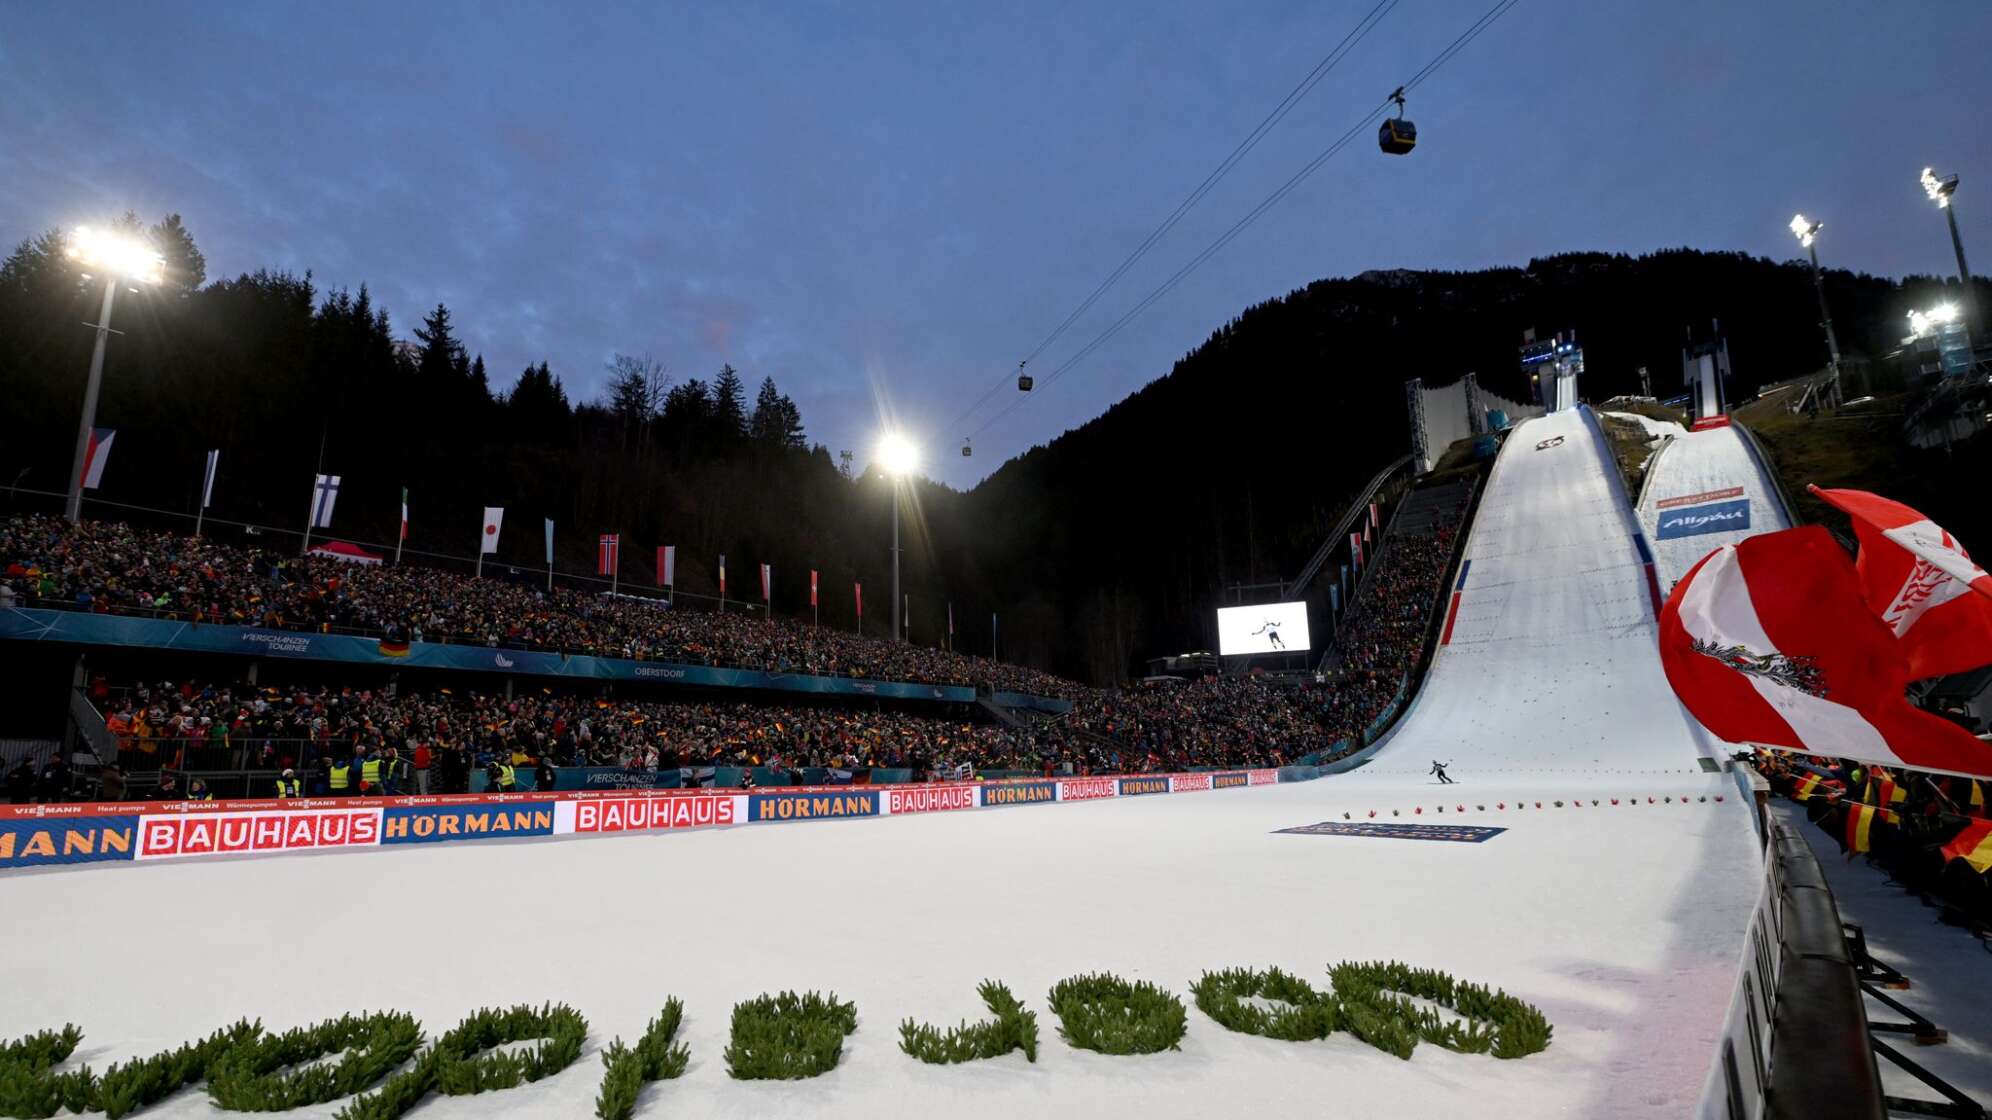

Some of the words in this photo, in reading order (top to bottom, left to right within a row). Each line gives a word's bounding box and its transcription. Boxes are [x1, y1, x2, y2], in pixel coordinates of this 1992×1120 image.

[242, 632, 311, 645] VIERSCHANZEN
[268, 642, 307, 652] TOURNEE
[634, 667, 685, 678] OBERSTDORF
[586, 773, 658, 785] VIERSCHANZEN
[986, 784, 1052, 804] HÖRMANN
[1062, 781, 1114, 799] BAUHAUS
[118, 805, 146, 813] pumps
[759, 794, 873, 819] HÖRMANN
[890, 788, 973, 812] BAUHAUS
[579, 799, 732, 829] BAUHAUS
[147, 815, 374, 850] BAUHAUS
[385, 810, 552, 839] HÖRMANN
